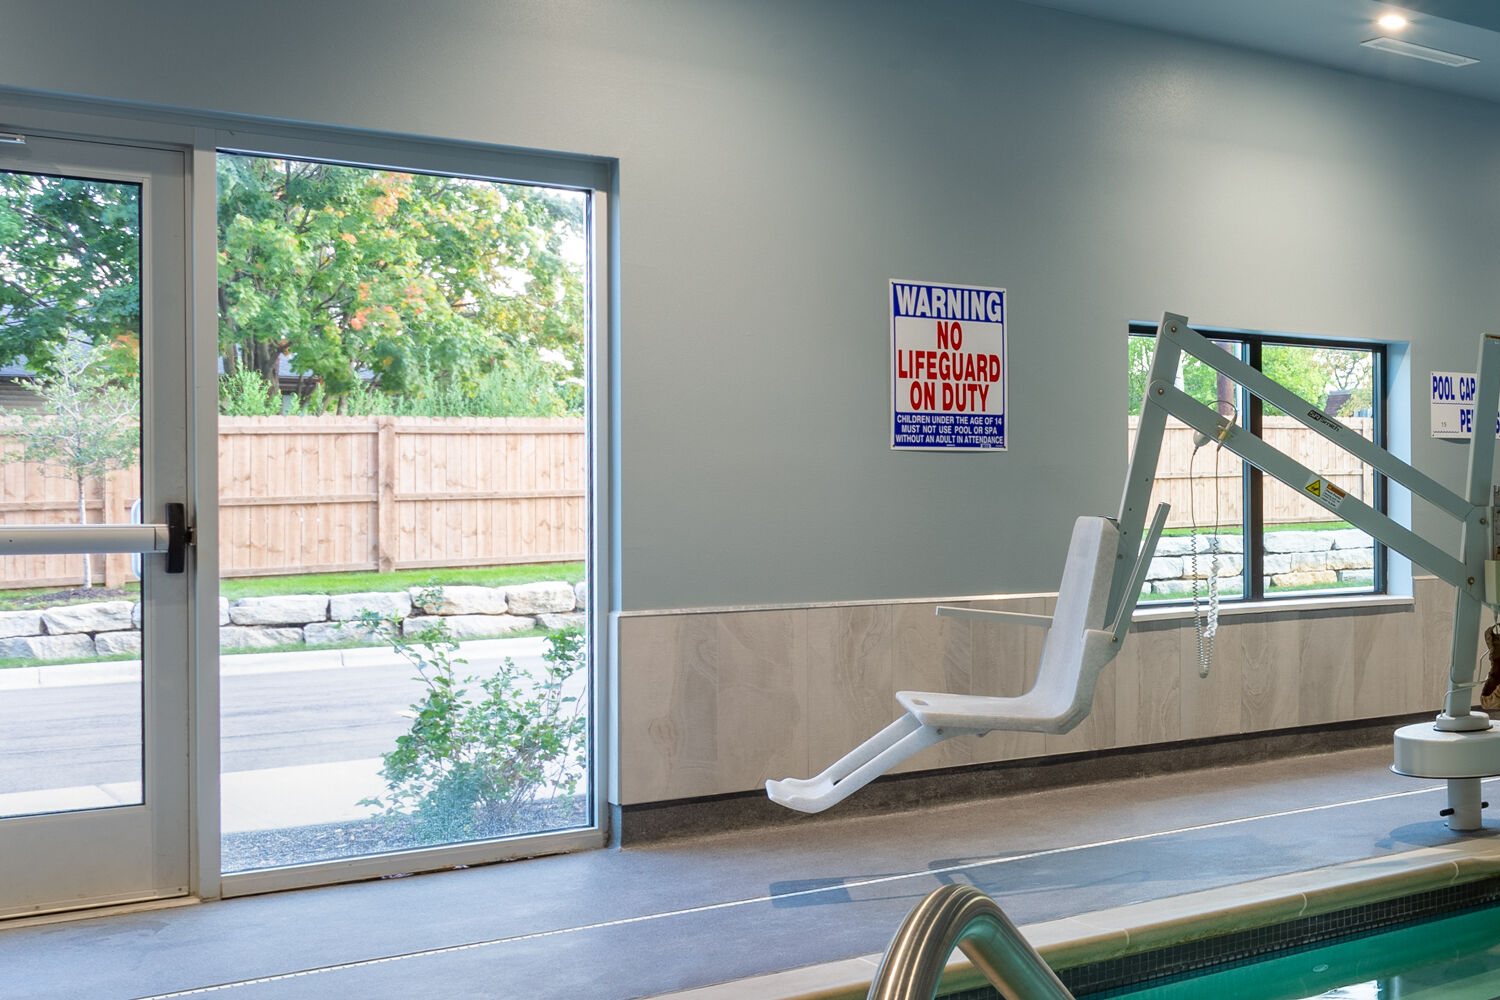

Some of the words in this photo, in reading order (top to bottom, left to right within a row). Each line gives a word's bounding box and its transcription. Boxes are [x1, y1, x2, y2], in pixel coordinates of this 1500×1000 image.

[896, 285, 1001, 322] WARNING
[937, 321, 962, 351] NO
[898, 350, 1000, 382] LIFEGUARD
[910, 381, 935, 410] ON
[942, 382, 990, 412] DUTY
[1432, 376, 1455, 400] POOL
[896, 414, 930, 424] CHILDREN
[932, 416, 954, 424] UNDER
[955, 416, 969, 425] THE
[970, 417, 983, 425] AGE
[901, 425, 920, 433] MUST
[922, 425, 936, 433] NOT
[939, 426, 952, 434] USE
[954, 426, 972, 434] POOL
[974, 426, 983, 434] OR
[984, 427, 998, 435] SPA
[896, 434, 924, 443] WITHOUT
[925, 435, 934, 443] AN
[936, 435, 956, 443] ADULT
[964, 436, 1003, 444] ATTENDANCE
